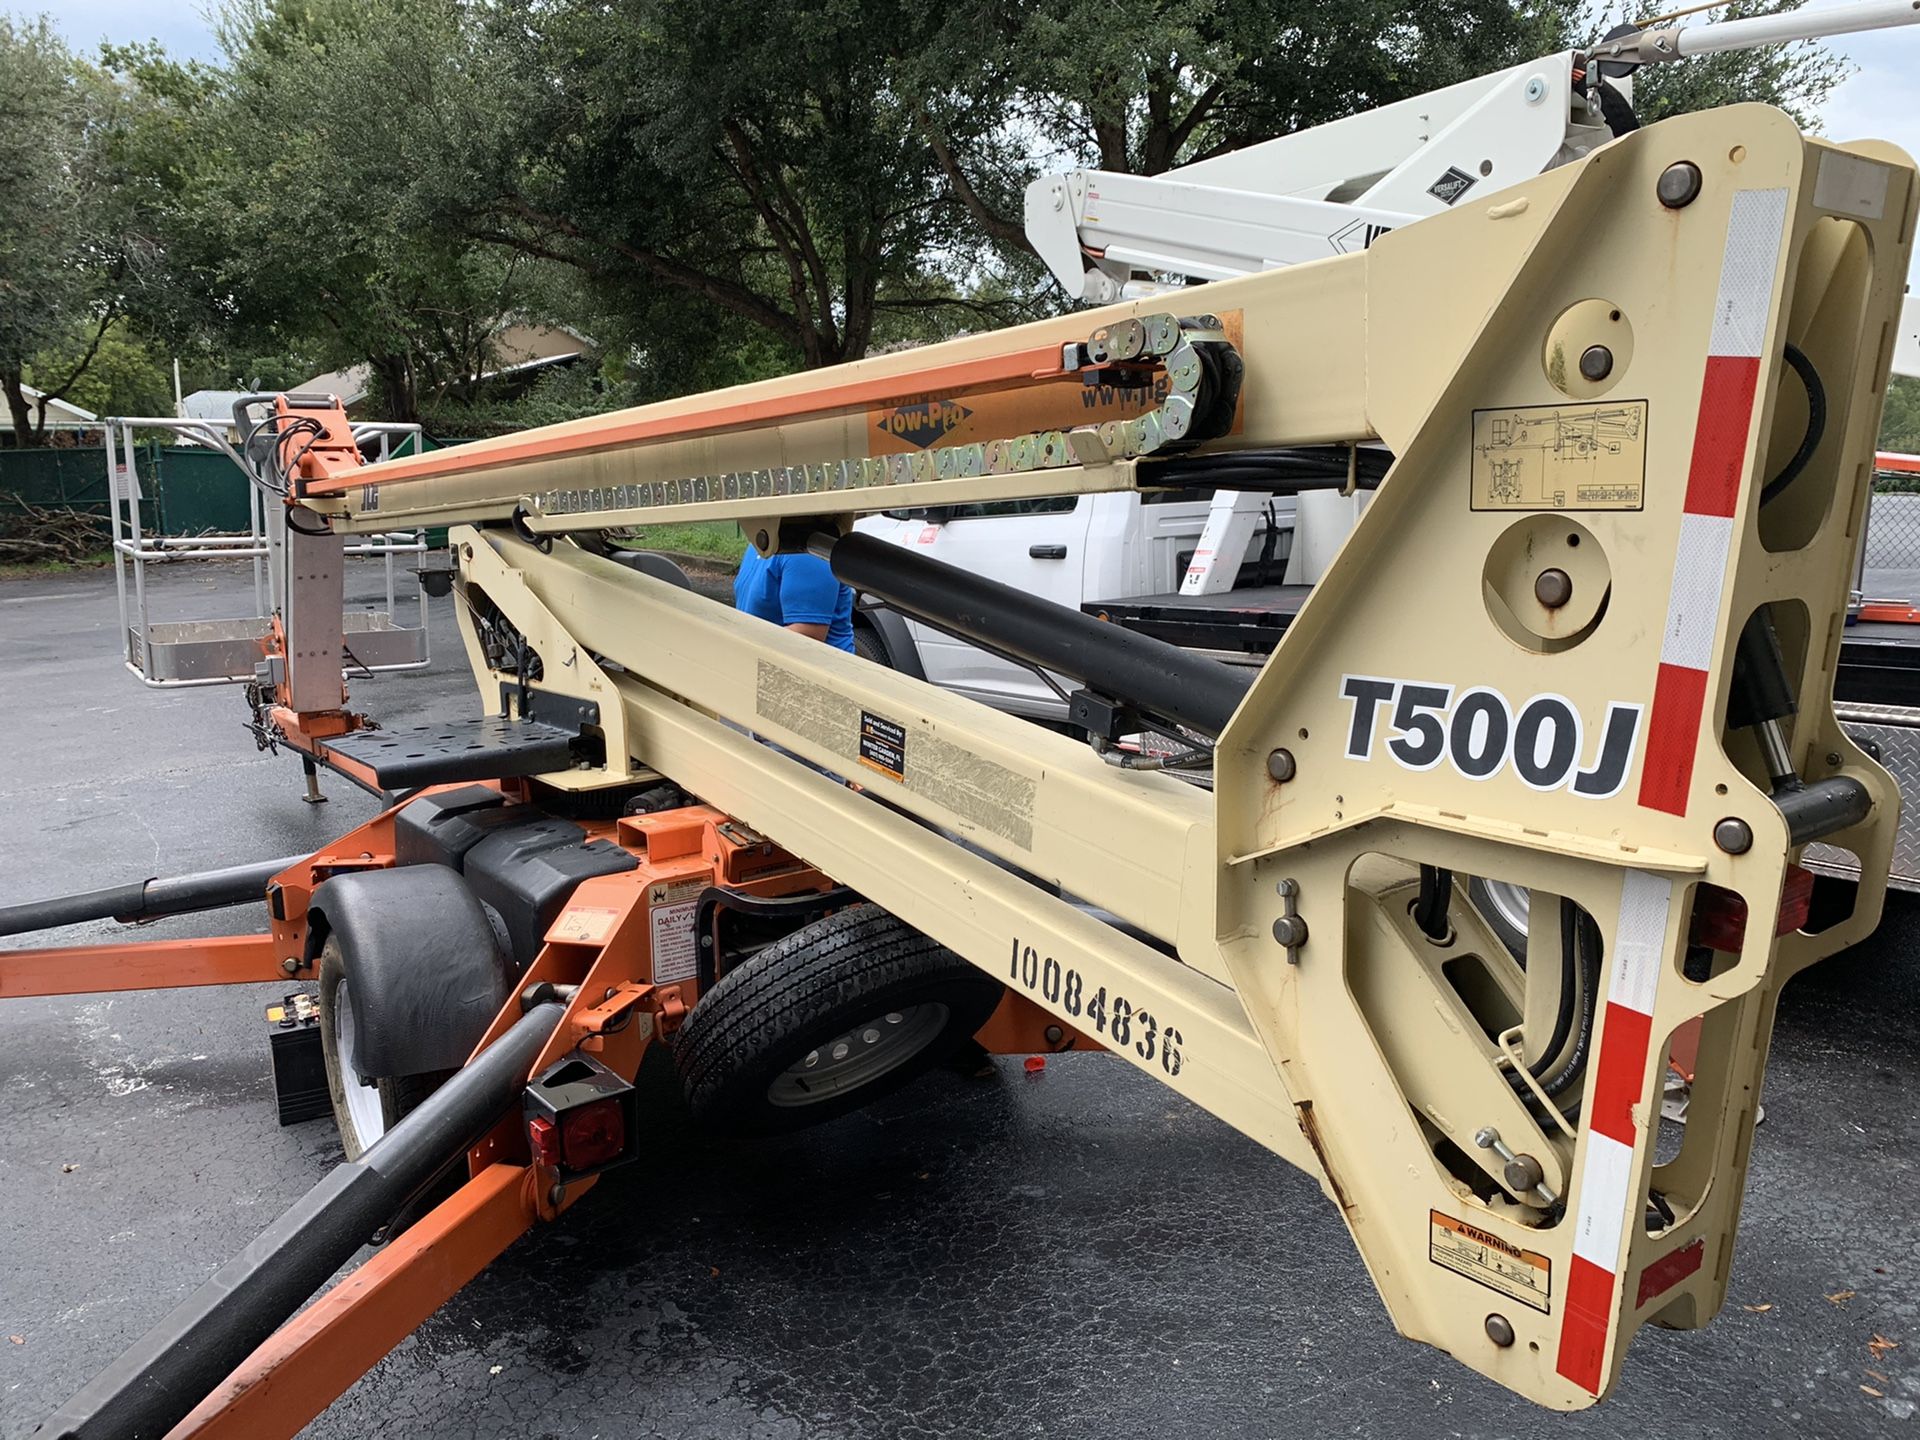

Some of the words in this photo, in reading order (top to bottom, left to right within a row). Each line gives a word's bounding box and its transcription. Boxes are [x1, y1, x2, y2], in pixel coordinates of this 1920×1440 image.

[1434, 180, 1462, 193] VERSALIFT
[1342, 676, 1642, 797] T500J
[657, 914, 682, 926] DAILY
[1010, 938, 1184, 1076] 10084836
[1466, 1227, 1522, 1258] WARNING
